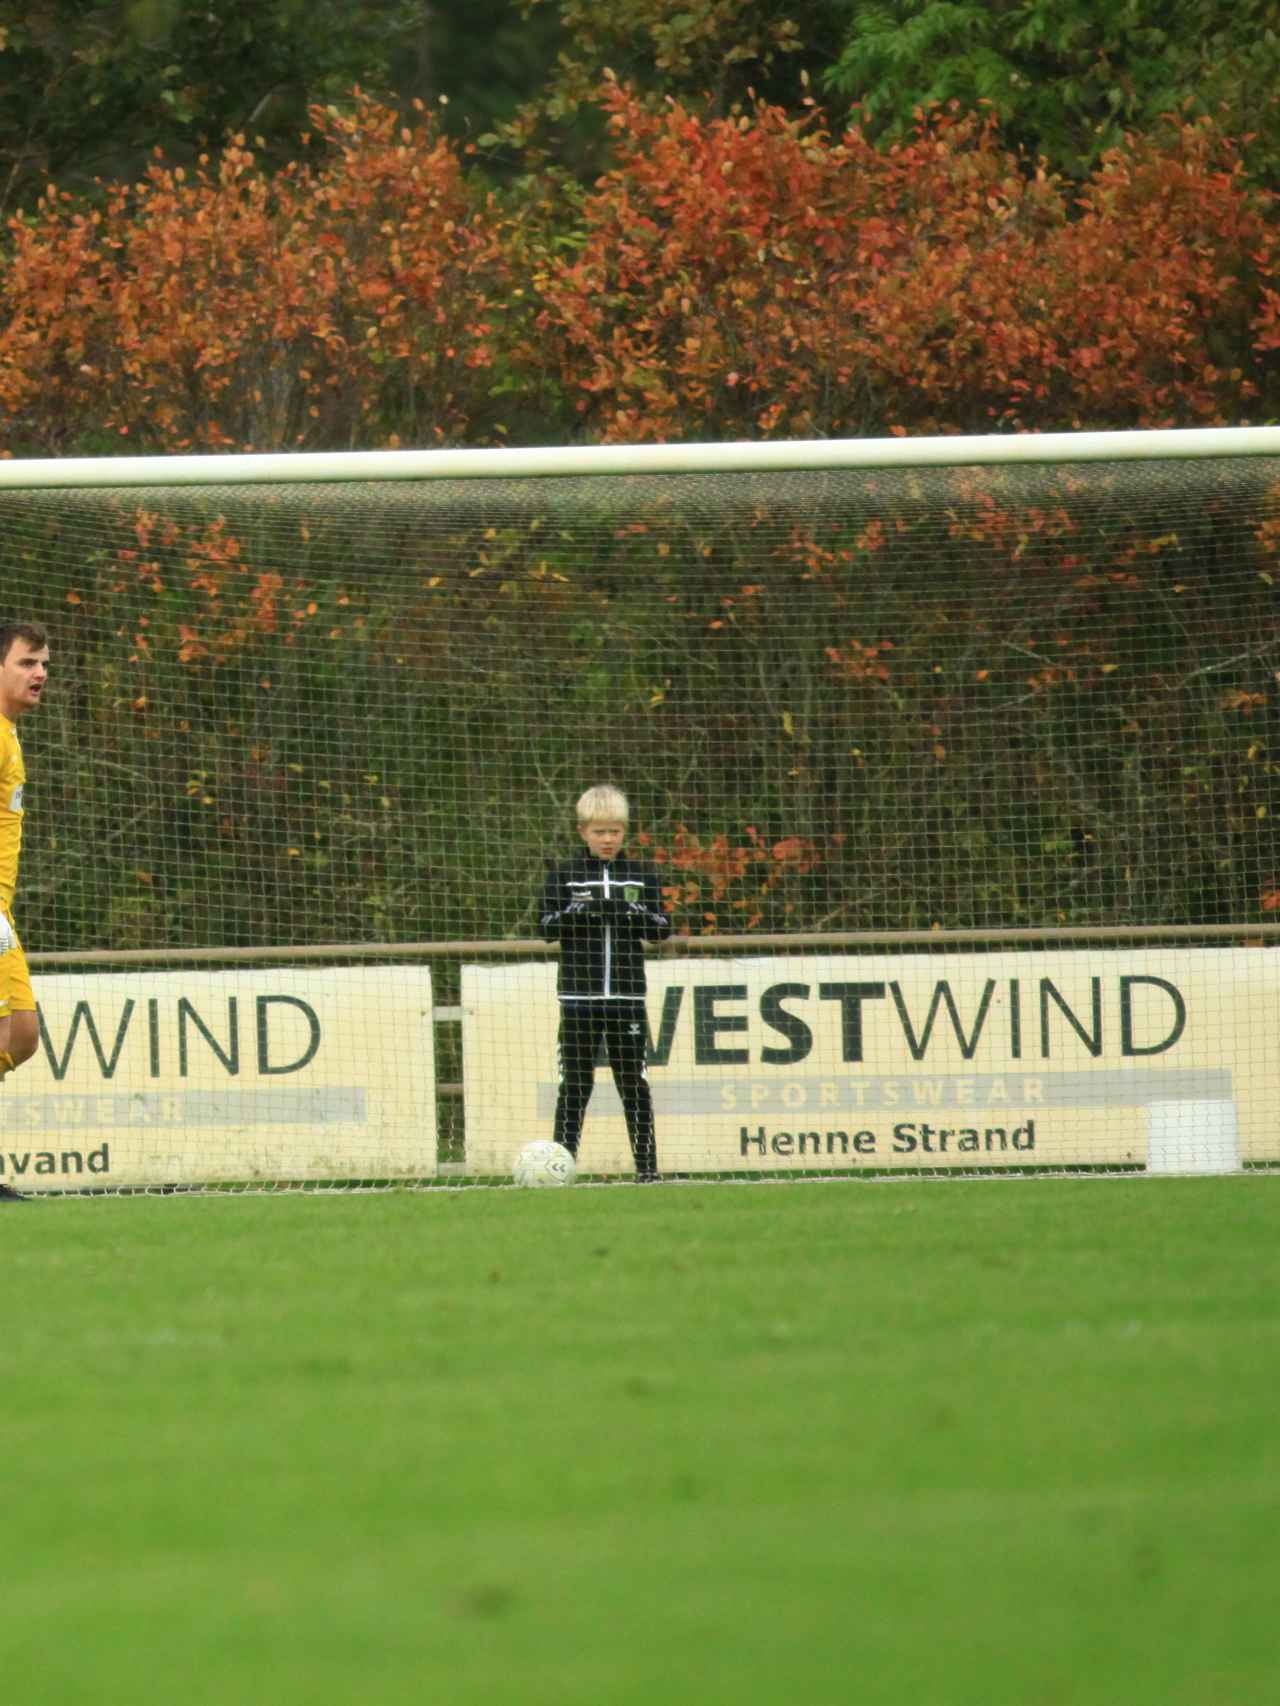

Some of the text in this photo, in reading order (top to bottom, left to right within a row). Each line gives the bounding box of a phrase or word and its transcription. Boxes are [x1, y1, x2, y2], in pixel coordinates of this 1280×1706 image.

[719, 1077, 1046, 1111] SPORTSWEAR
[739, 1119, 1036, 1158] Henne Strand
